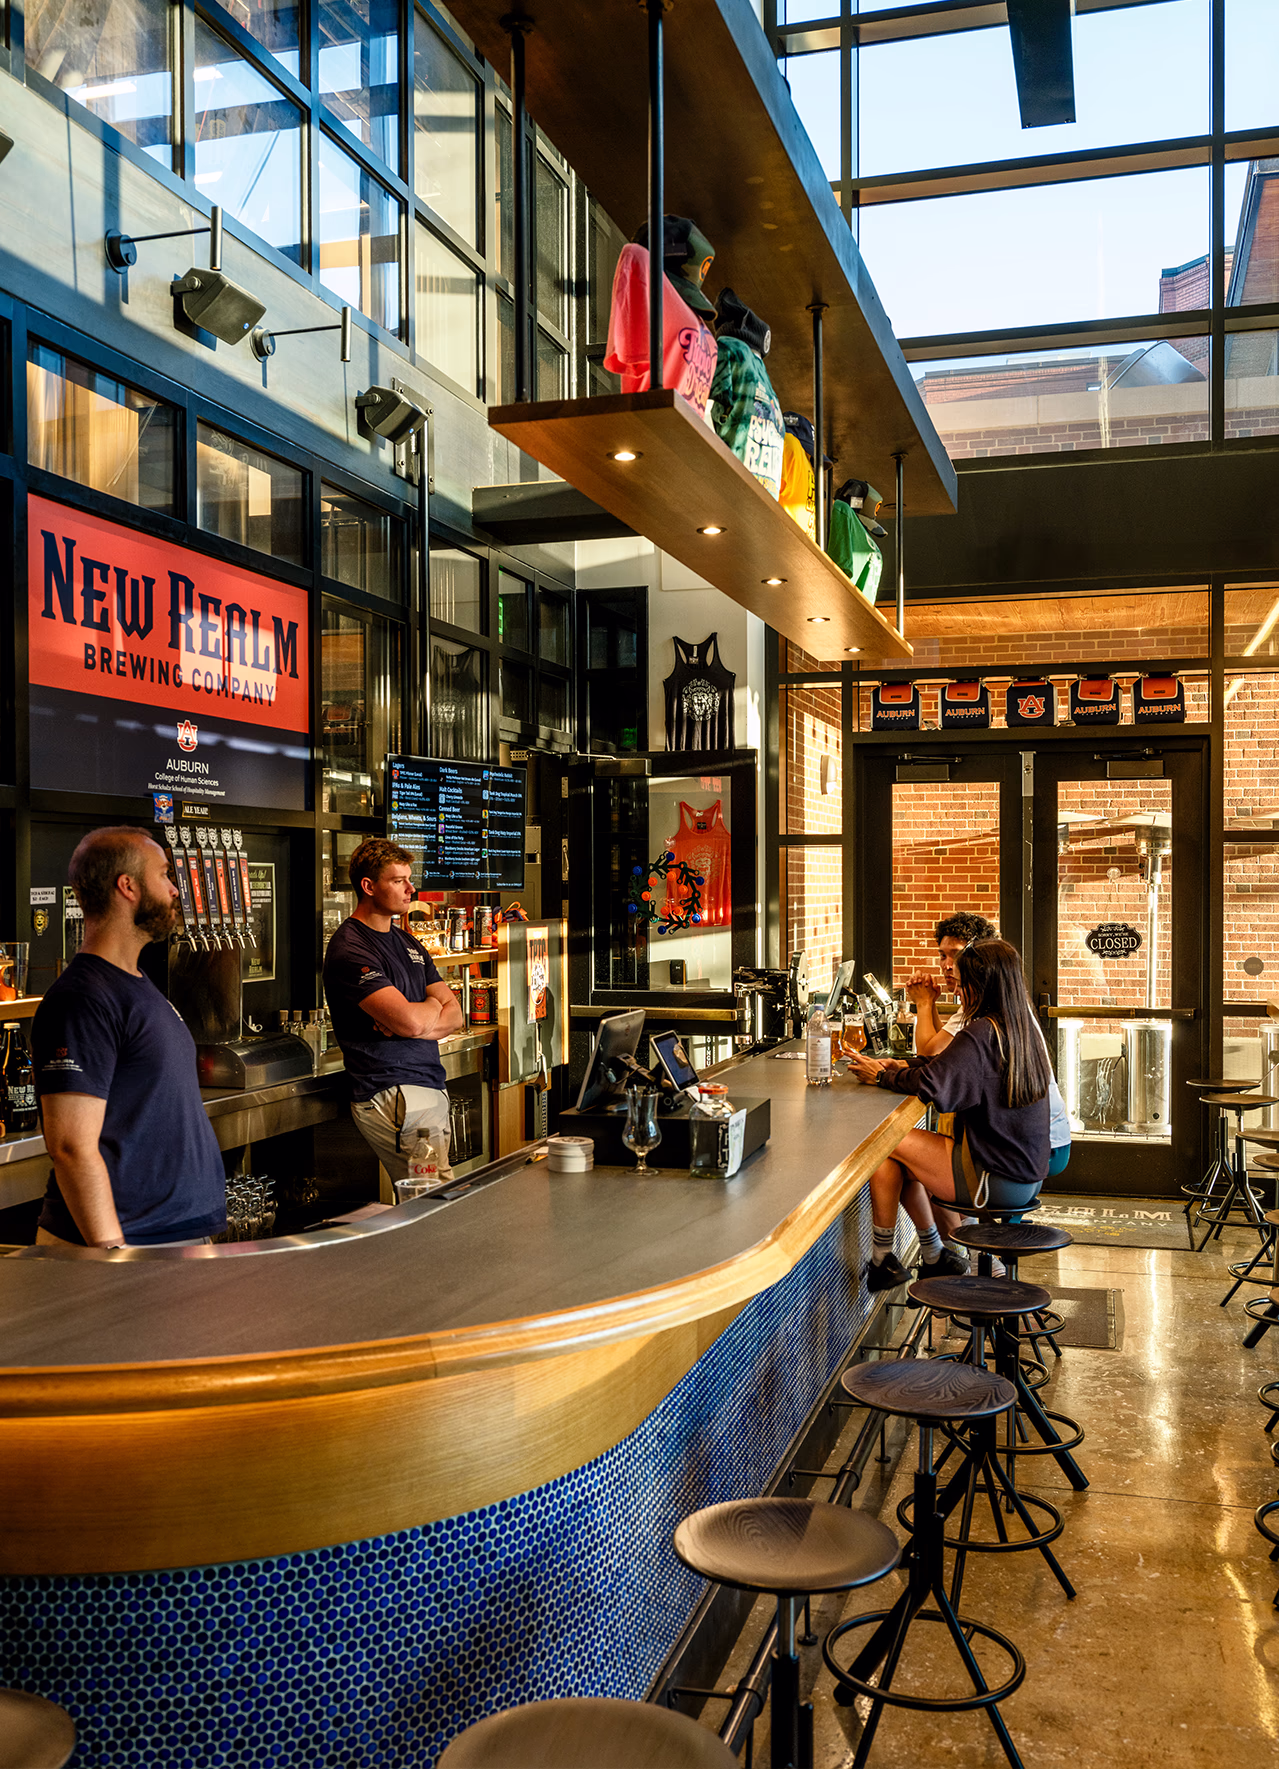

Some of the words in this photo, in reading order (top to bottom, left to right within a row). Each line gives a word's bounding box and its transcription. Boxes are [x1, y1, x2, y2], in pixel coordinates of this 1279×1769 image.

[40, 529, 155, 641] NEW
[168, 570, 299, 679] REALM
[84, 643, 183, 688] BREWING
[192, 669, 274, 707] COMPANY
[876, 709, 915, 718] AUBURN
[945, 707, 985, 716] AUBURN
[1074, 704, 1116, 714] AUBURN
[1138, 704, 1181, 714] AUBURN
[166, 759, 209, 774] AUBURN
[155, 772, 174, 783] College
[181, 776, 197, 784] Human
[198, 777, 219, 786] Sciences
[1091, 937, 1137, 950] CLOSED
[414, 1164, 437, 1174] Coke
